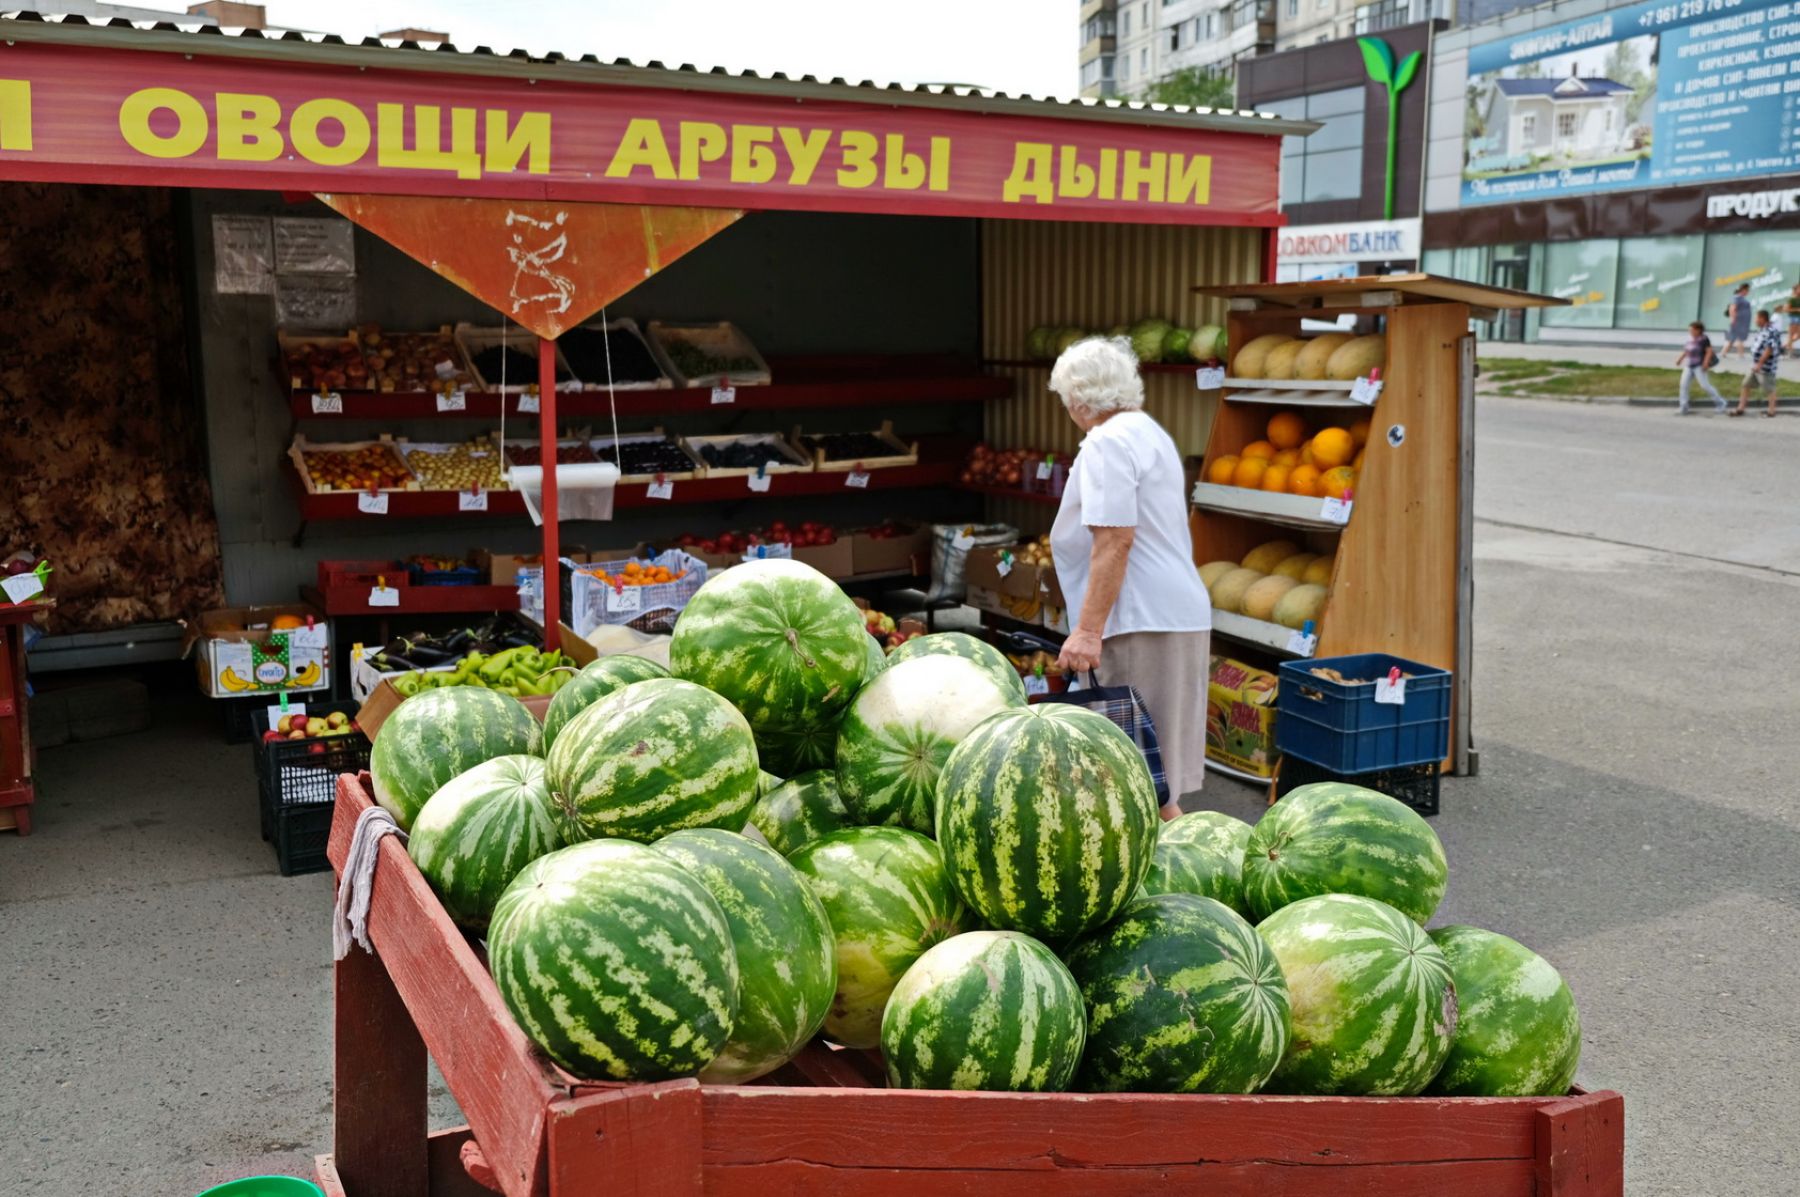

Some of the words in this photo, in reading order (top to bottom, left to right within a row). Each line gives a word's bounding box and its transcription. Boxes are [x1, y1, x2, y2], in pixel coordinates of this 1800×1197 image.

[119, 87, 552, 181] ОВОЩИ
[604, 118, 951, 192] АРБУЗЫ
[1003, 142, 1212, 205] ДЫНИ
[1706, 187, 1800, 219] ПРОДУК
